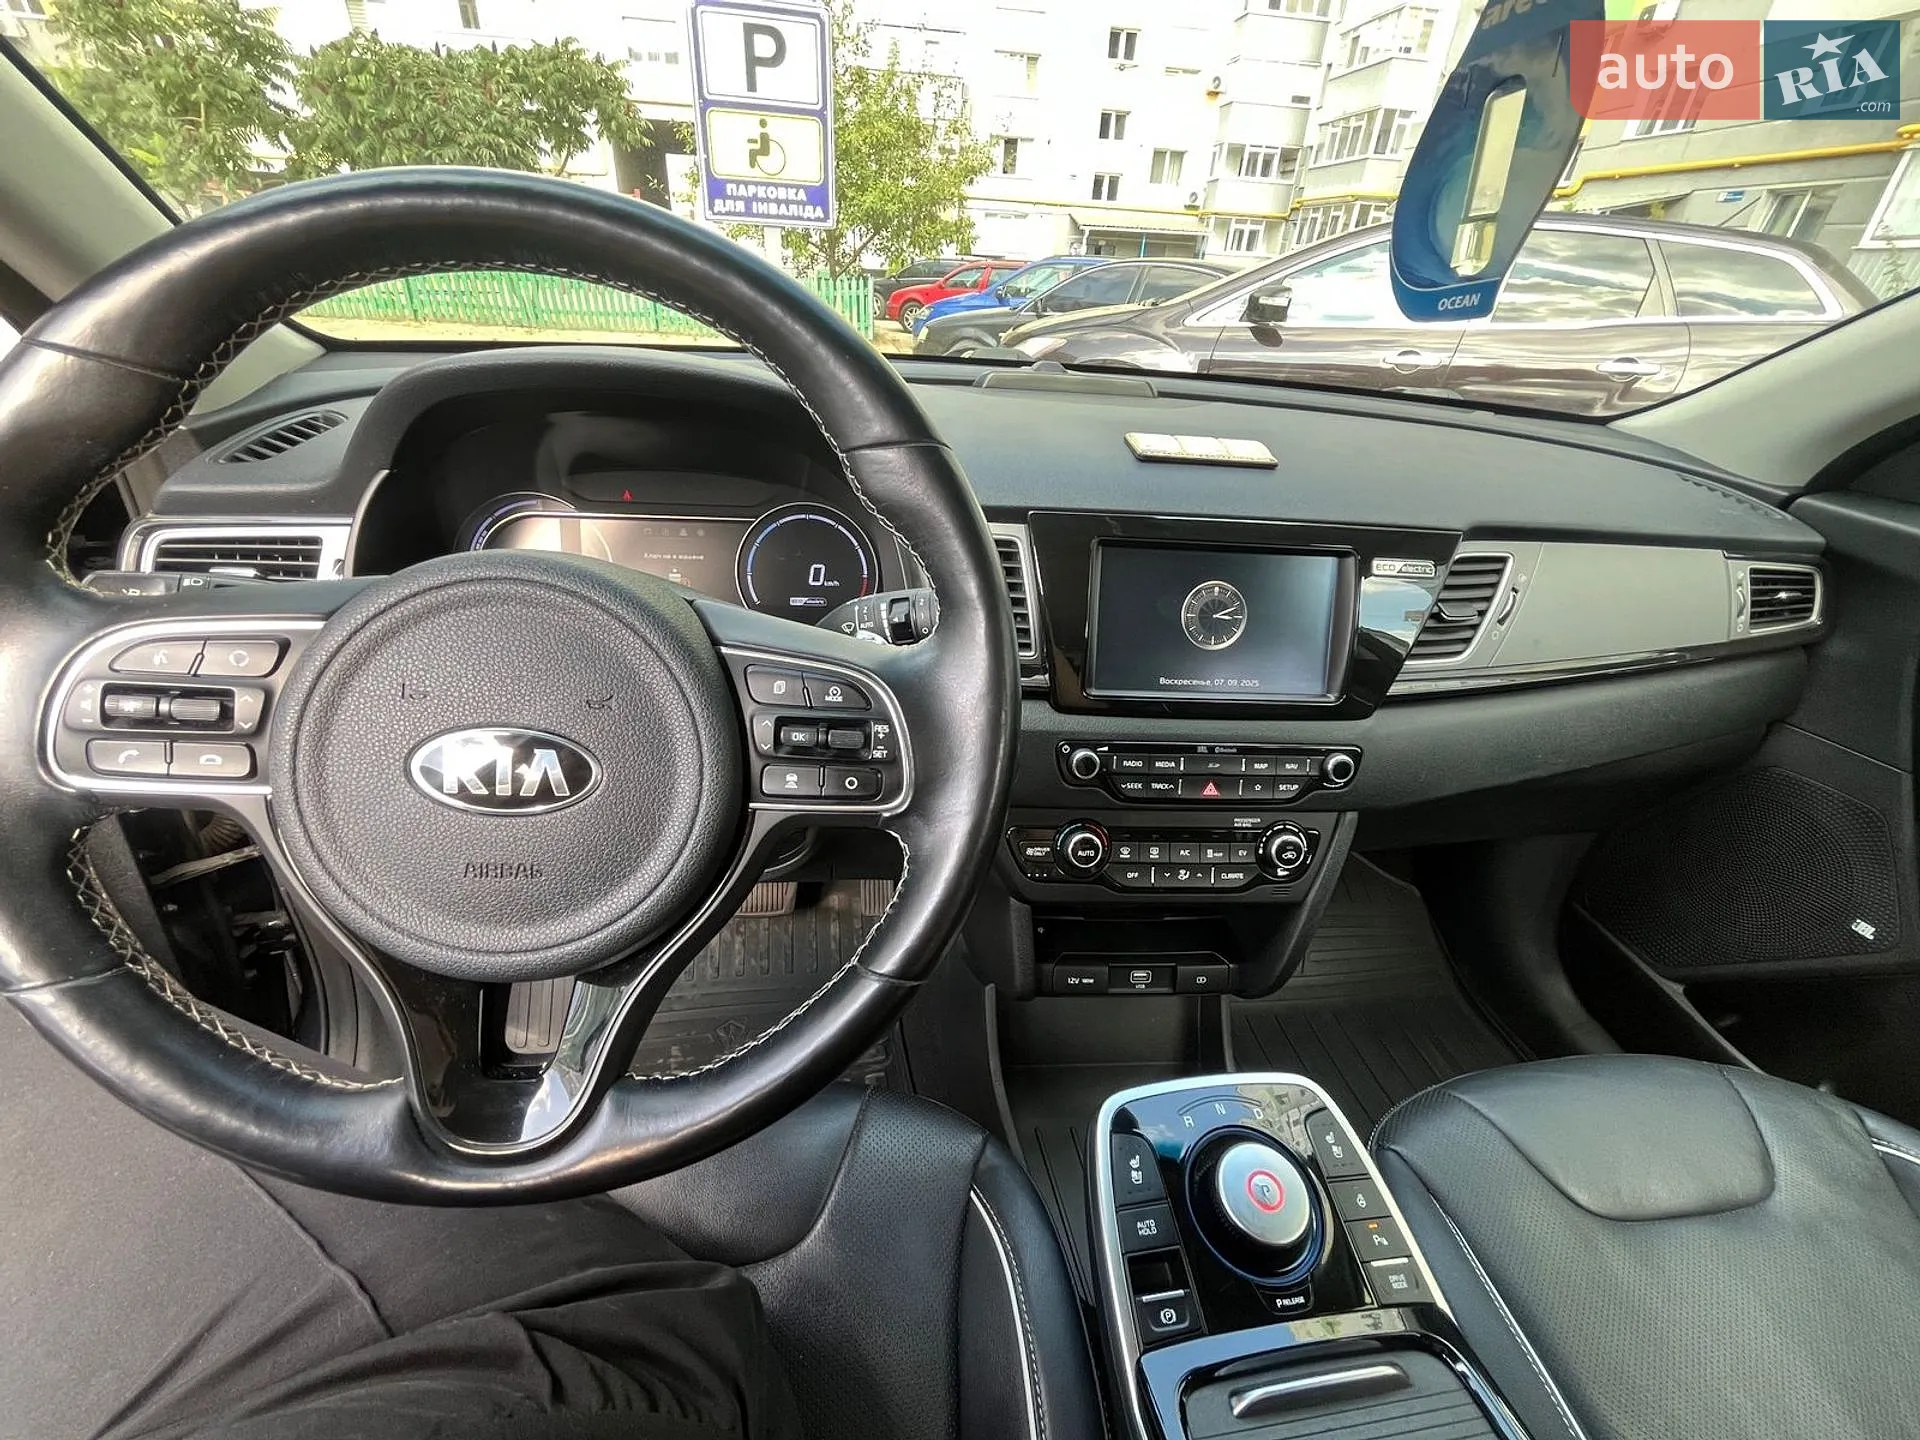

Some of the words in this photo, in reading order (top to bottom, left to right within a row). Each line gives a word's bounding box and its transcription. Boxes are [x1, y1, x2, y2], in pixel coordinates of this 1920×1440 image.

[742, 22, 787, 92] P
[726, 183, 807, 201] ПАРКОВКА
[713, 199, 745, 213] ДЛЯ
[752, 202, 825, 219] ІНВАЛІДА
[1437, 292, 1481, 311] OCEAN
[1375, 563, 1396, 571] ECO
[808, 563, 826, 586] 0
[874, 724, 889, 733] RES
[792, 732, 805, 742] OK
[872, 750, 888, 759] SET
[1155, 760, 1175, 768] MEDIA
[442, 744, 571, 797] KIA
[1126, 782, 1143, 790] SEEK
[1278, 783, 1299, 791] SETUP
[1067, 977, 1080, 985] 12V
[1215, 1103, 1226, 1116] N
[1252, 1107, 1264, 1120] D
[1183, 1115, 1194, 1128] R
[1136, 1219, 1156, 1229] AUTO
[1137, 1226, 1158, 1236] HOLD
